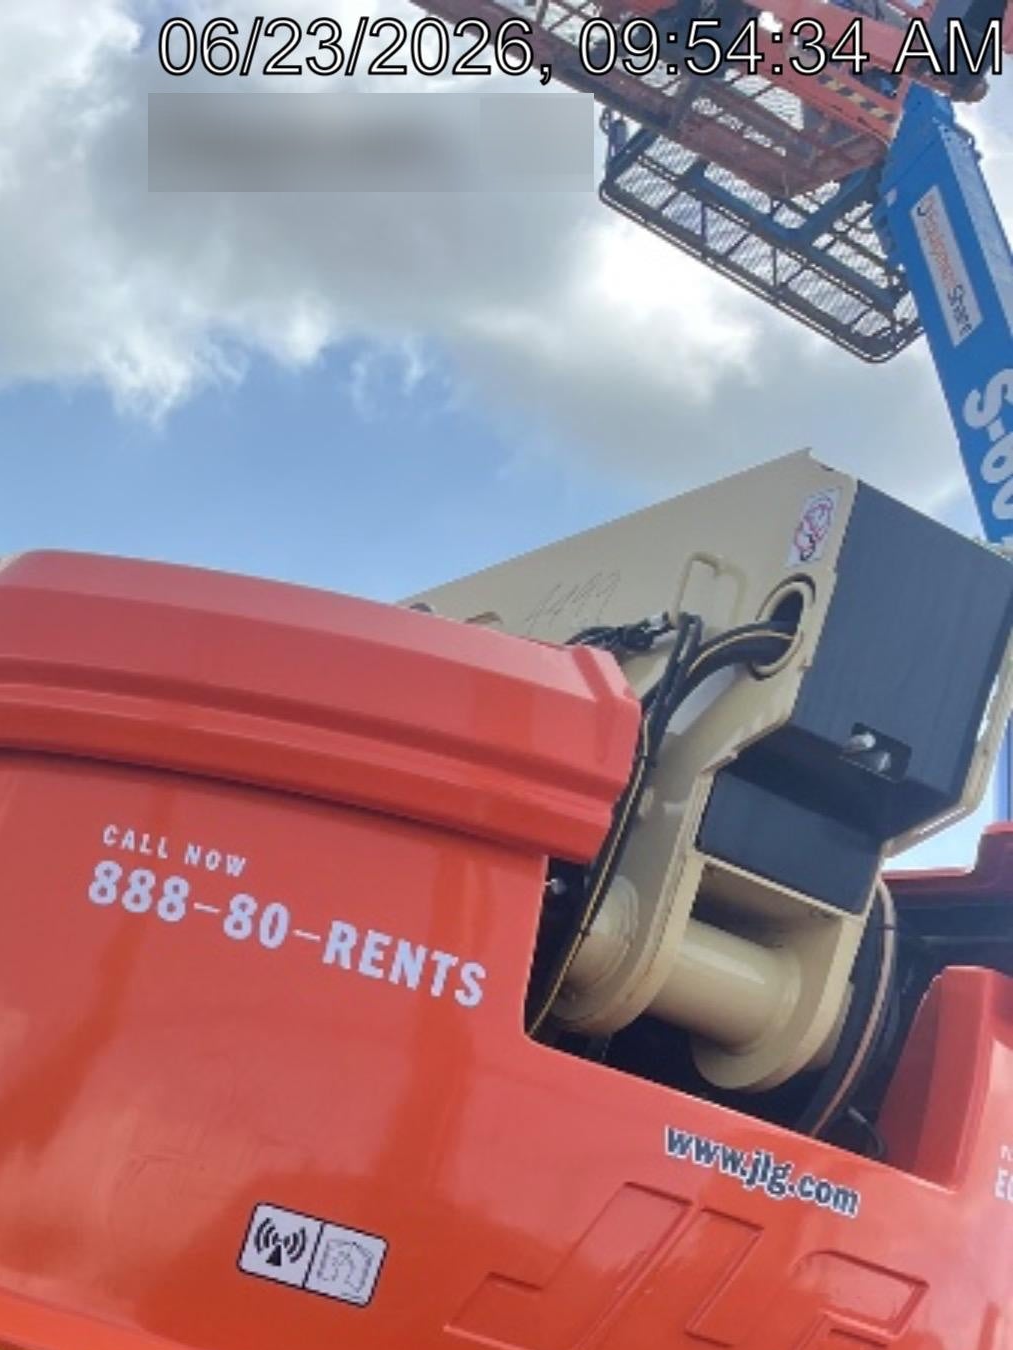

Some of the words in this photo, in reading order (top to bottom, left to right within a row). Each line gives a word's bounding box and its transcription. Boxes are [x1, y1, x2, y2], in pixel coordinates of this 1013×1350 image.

[103, 824, 169, 859] CALL
[184, 843, 246, 877] NOW
[89, 860, 487, 1007] 888-80-RENTS
[665, 1125, 861, 1218] www.jlg.com
